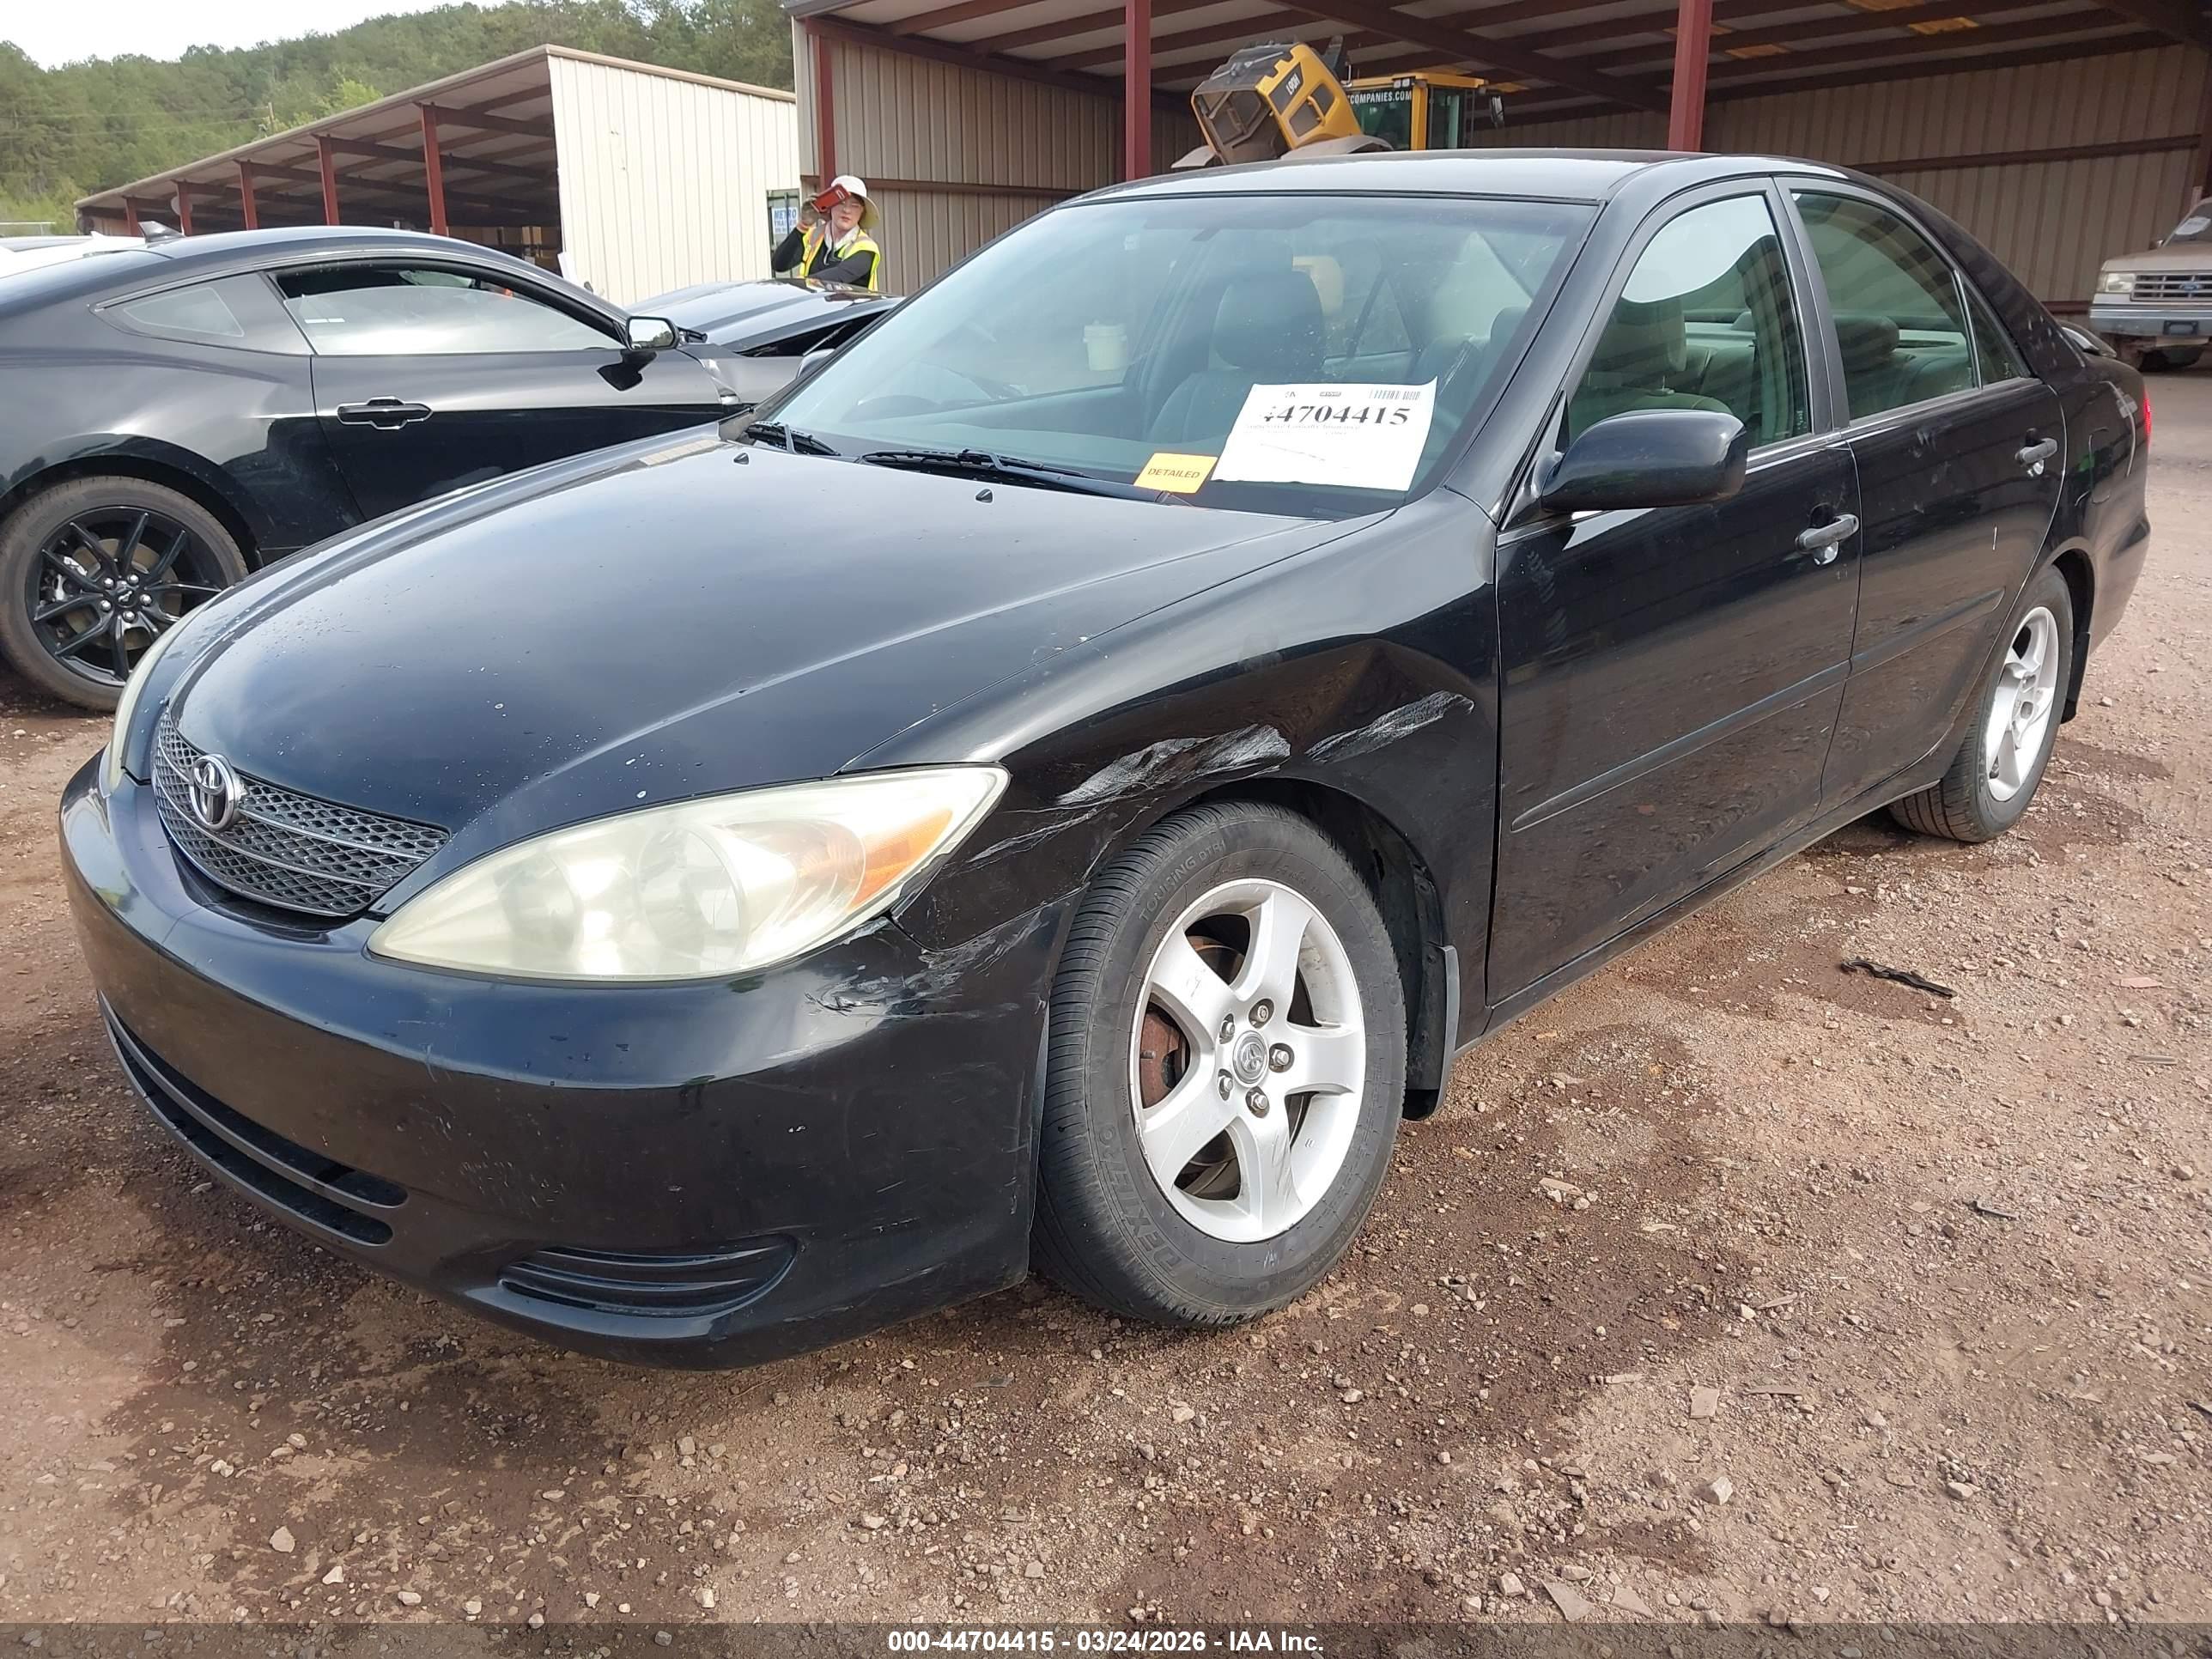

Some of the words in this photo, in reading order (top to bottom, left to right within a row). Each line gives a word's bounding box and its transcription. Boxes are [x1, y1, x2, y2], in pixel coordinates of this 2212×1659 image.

[1347, 90, 1412, 105] COMPANIES.COM
[1147, 468, 1201, 478] DETAILED
[1138, 857, 1197, 923] TOURING
